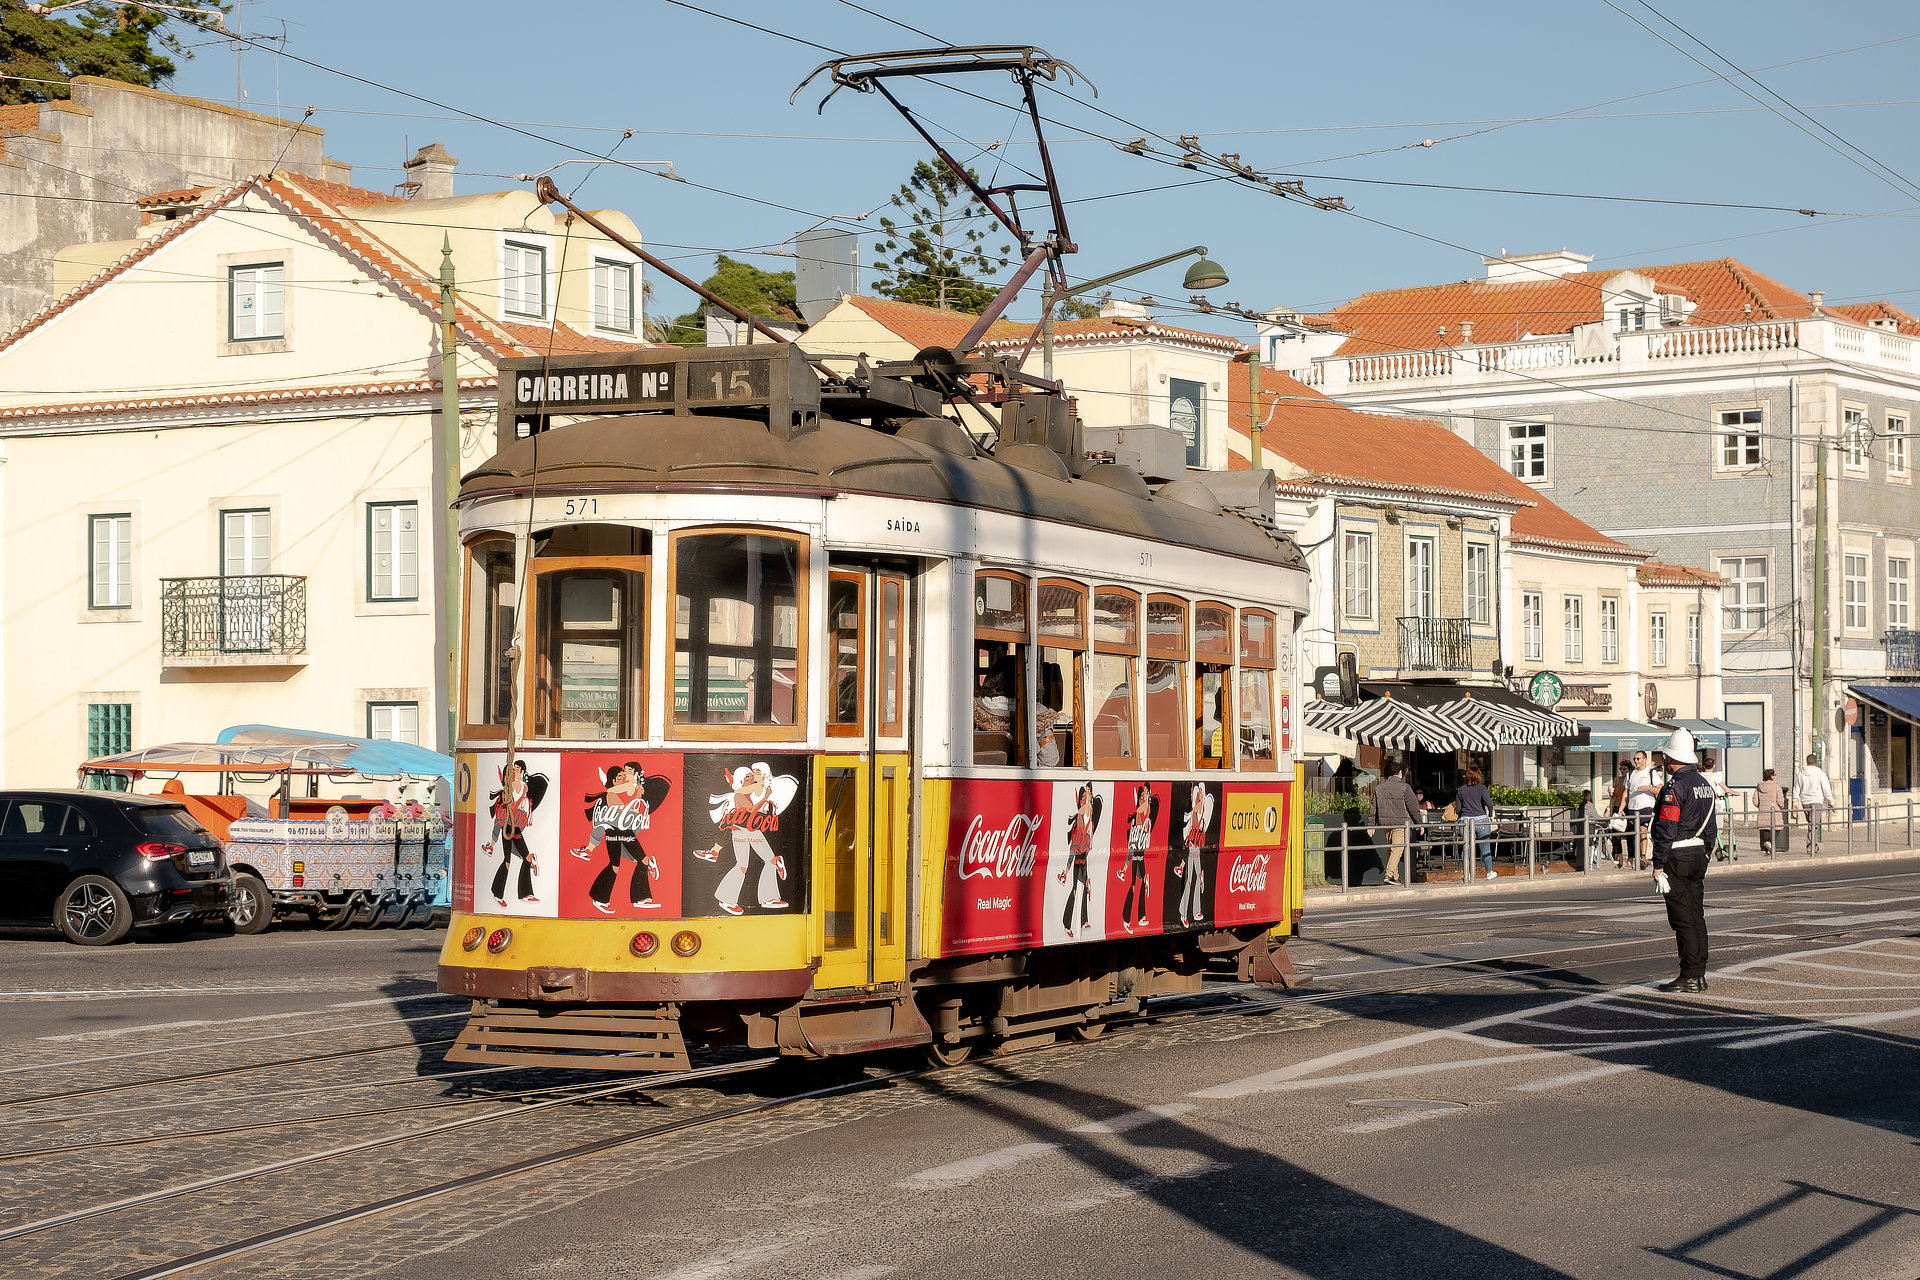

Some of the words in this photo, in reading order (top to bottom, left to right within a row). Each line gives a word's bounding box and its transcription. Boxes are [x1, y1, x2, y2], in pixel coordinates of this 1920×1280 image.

[517, 373, 628, 402] CARREIRA
[642, 371, 669, 398] Nº
[711, 370, 750, 400] 15
[565, 498, 597, 516] 571
[887, 516, 920, 533] SAÍDA
[1140, 552, 1153, 568] 571
[707, 694, 746, 707] RÓNIMOS
[593, 798, 651, 831] Coca-Cola
[1231, 804, 1260, 830] carris
[618, 835, 636, 843] Magic
[958, 813, 1044, 880] Coca-Cola
[1229, 854, 1271, 894] Coca-Cola
[977, 898, 992, 910] Real
[992, 896, 1012, 911] Magic
